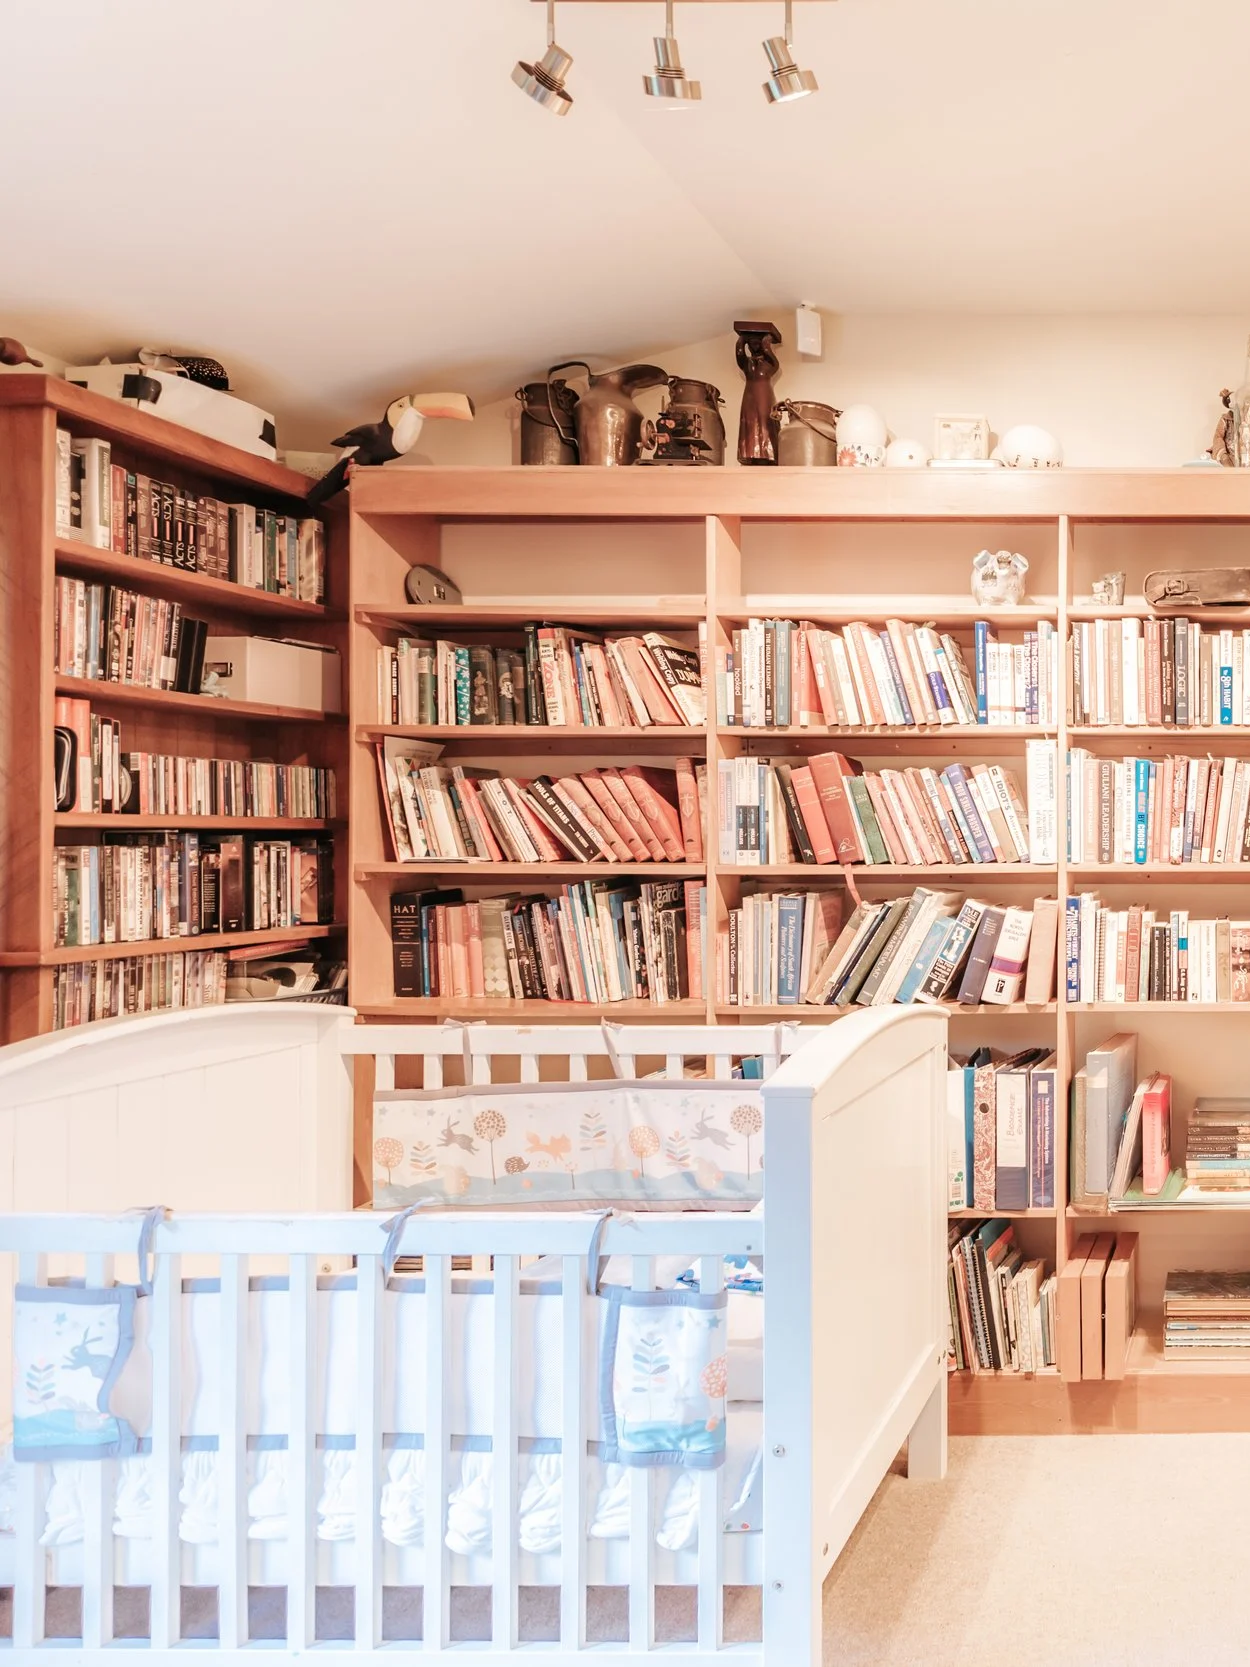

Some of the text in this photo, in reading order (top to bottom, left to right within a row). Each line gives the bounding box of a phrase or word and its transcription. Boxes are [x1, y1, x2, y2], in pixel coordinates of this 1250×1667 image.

[152, 492, 160, 517] ACTS
[164, 496, 174, 520] ACTS
[176, 542, 184, 566] ACTS
[652, 648, 676, 684] Writing Copy
[883, 637, 900, 684] PATRICK LENCIONI
[544, 662, 556, 698] ZONE
[1221, 676, 1232, 688] 8th
[532, 781, 570, 824] TOOLS OF TITANS
[996, 780, 1012, 810] IDIOT'S
[953, 782, 981, 840] THOU SHALL PROSPER
[1138, 814, 1144, 822] BY
[394, 905, 416, 914] HAT
[787, 916, 796, 924] The
[894, 904, 914, 936] BYZANTINE
[786, 925, 796, 950] Dictionary
[787, 958, 795, 970] South
[876, 940, 896, 968] MEDIEVAL
[786, 971, 795, 991] African
[872, 967, 880, 978] ART
